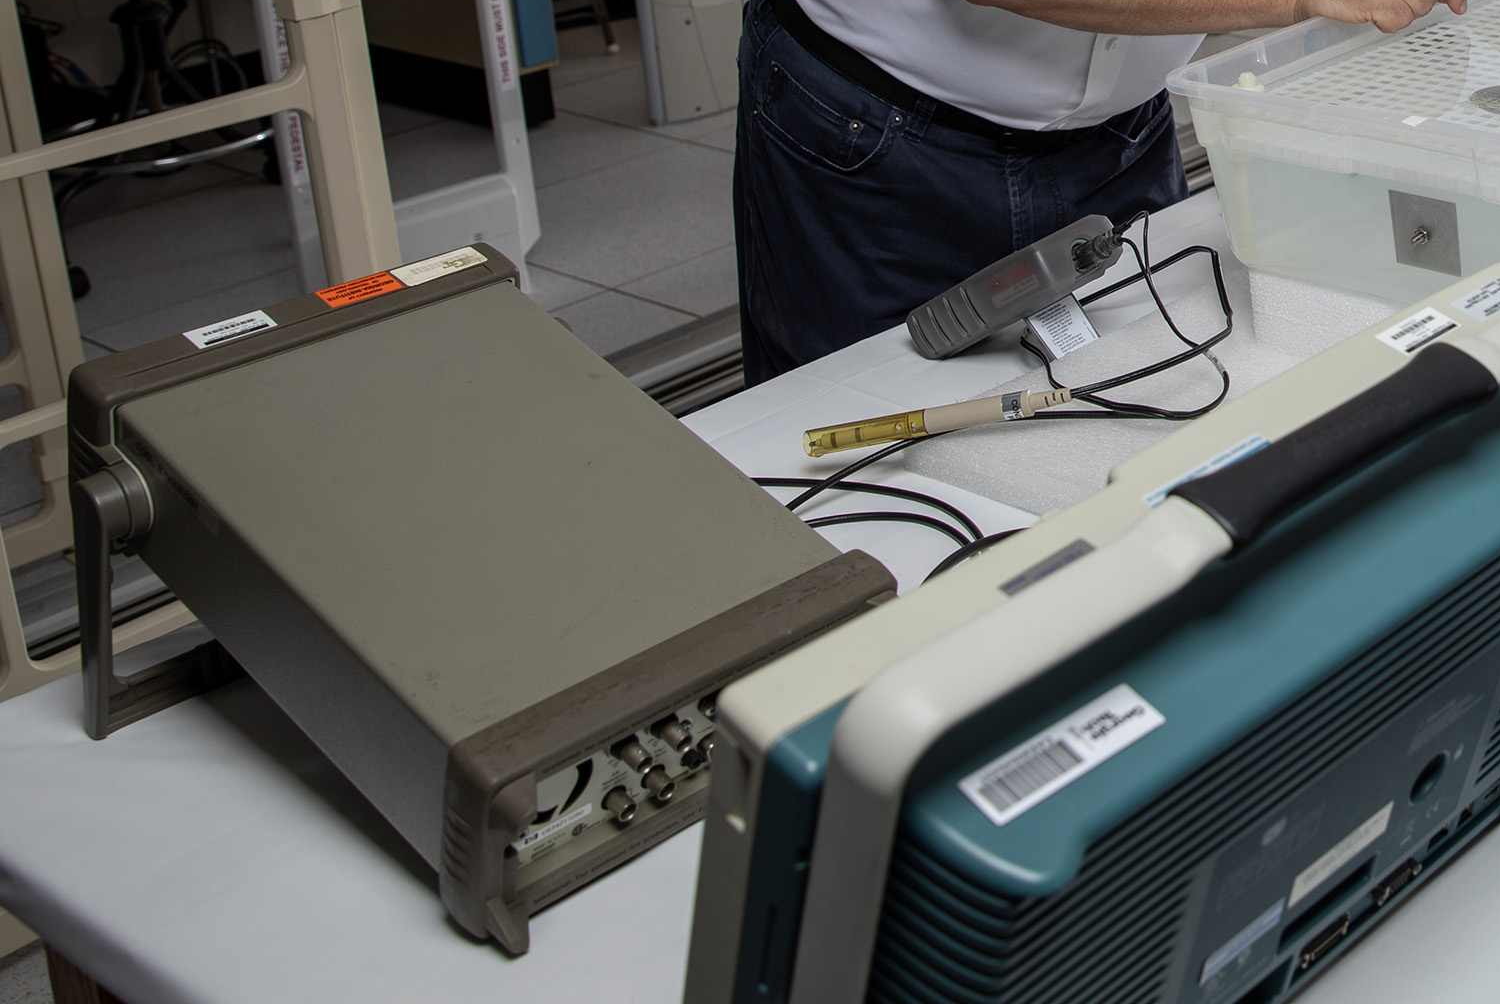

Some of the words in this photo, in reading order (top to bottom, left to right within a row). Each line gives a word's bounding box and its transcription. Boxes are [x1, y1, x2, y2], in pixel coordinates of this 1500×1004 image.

[491, 3, 504, 32] MUST
[496, 34, 509, 58] SIDE
[500, 59, 511, 83] THIS
[289, 115, 304, 173] PEDESTAL
[326, 289, 362, 302] INSTITUTE
[362, 279, 394, 291] GEORGIA
